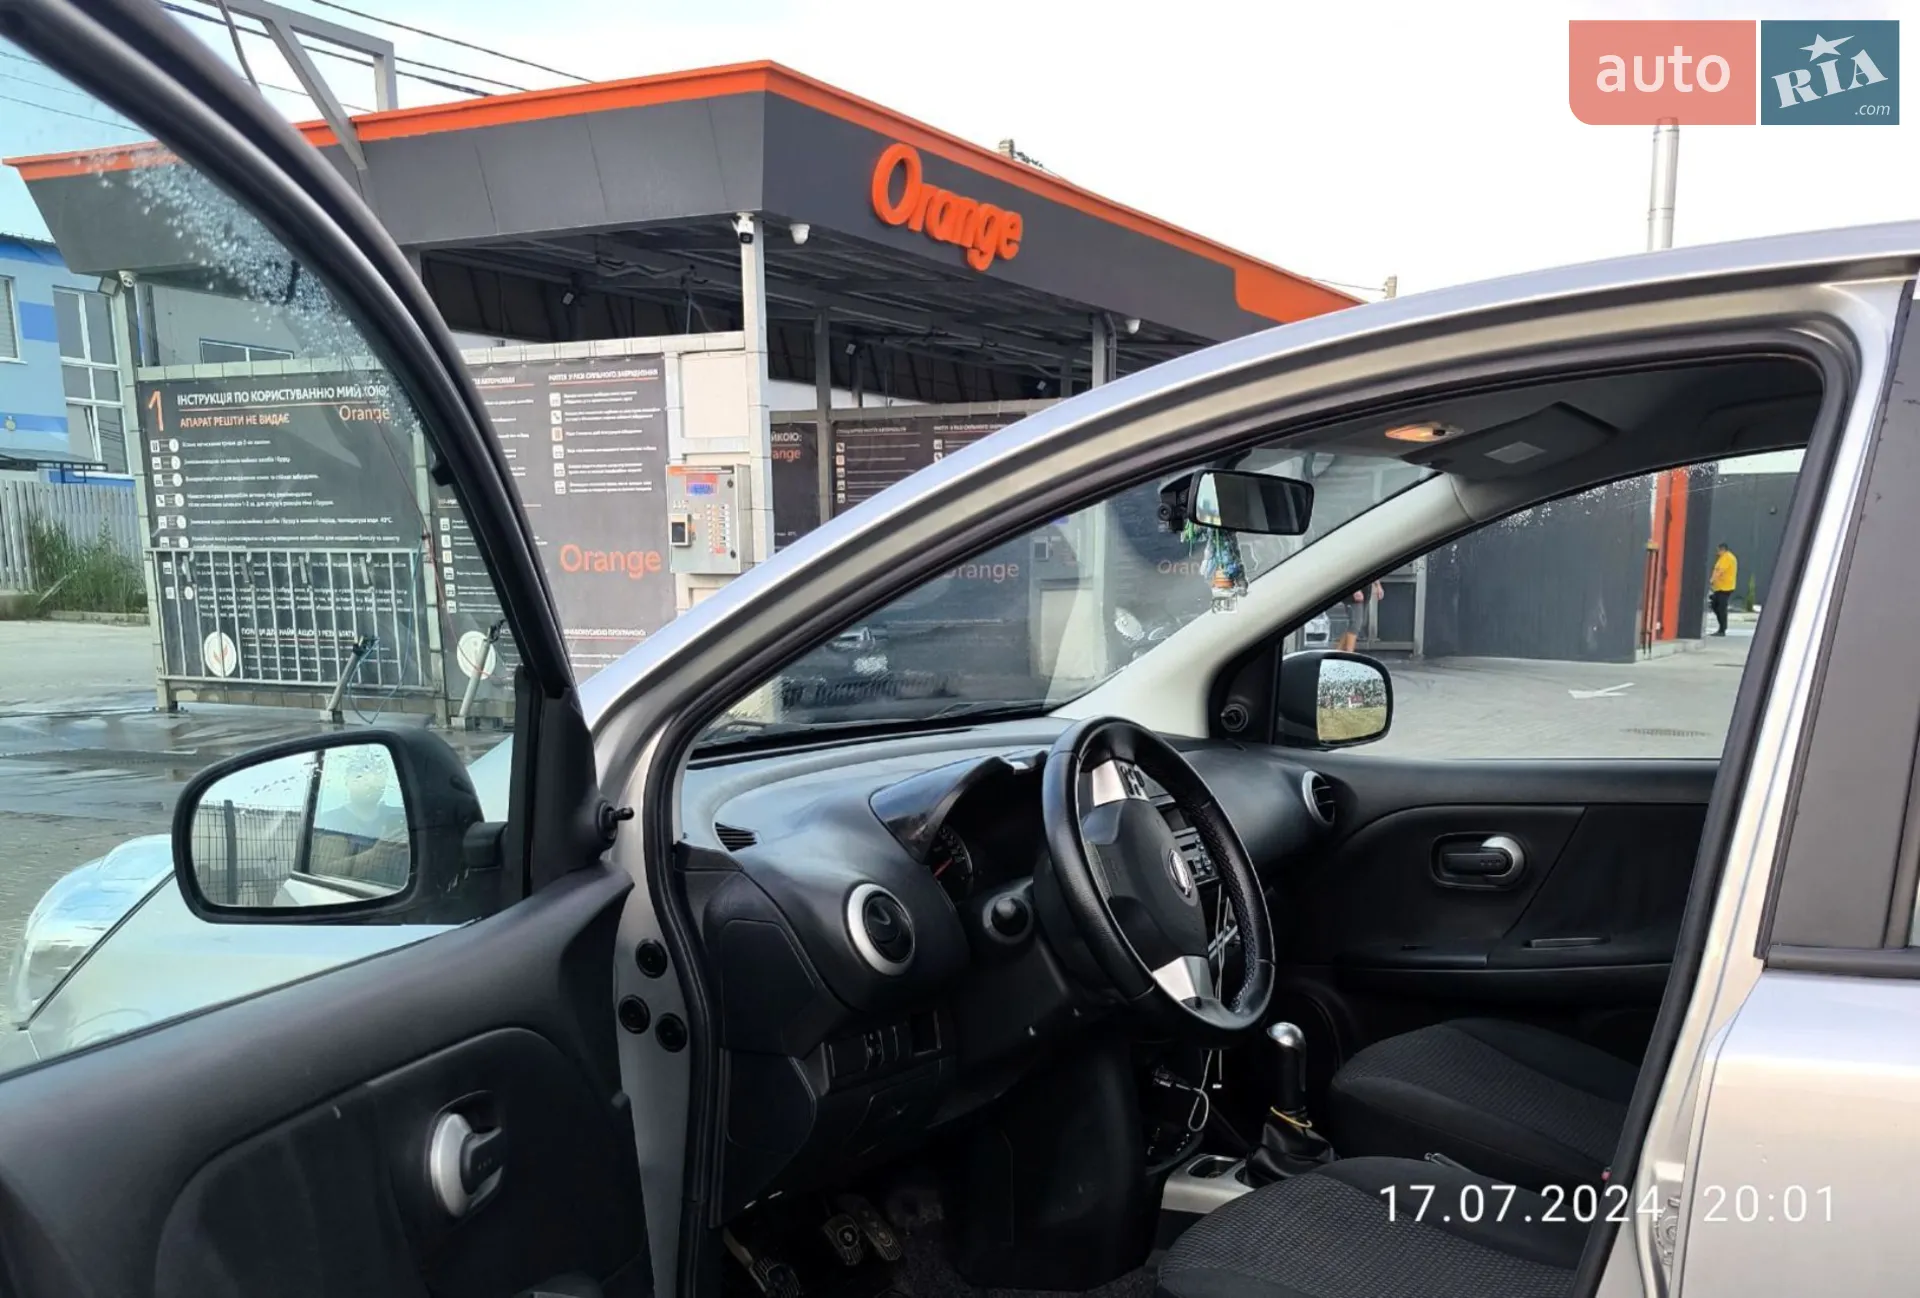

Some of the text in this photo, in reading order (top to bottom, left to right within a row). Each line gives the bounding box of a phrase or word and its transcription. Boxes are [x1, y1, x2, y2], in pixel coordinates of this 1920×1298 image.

[871, 142, 1023, 272] Orange
[177, 392, 233, 406] ІНСТРУКЦІЯ
[234, 391, 250, 404] ПО
[250, 387, 335, 403] КОРИСТУВАННЮ
[148, 389, 165, 432] 1
[180, 412, 291, 429] АПАРАТ РЕШТИ НЕ ВИДАЄ
[338, 404, 391, 424] Orange
[772, 450, 801, 463] ange
[560, 543, 662, 580] Orange
